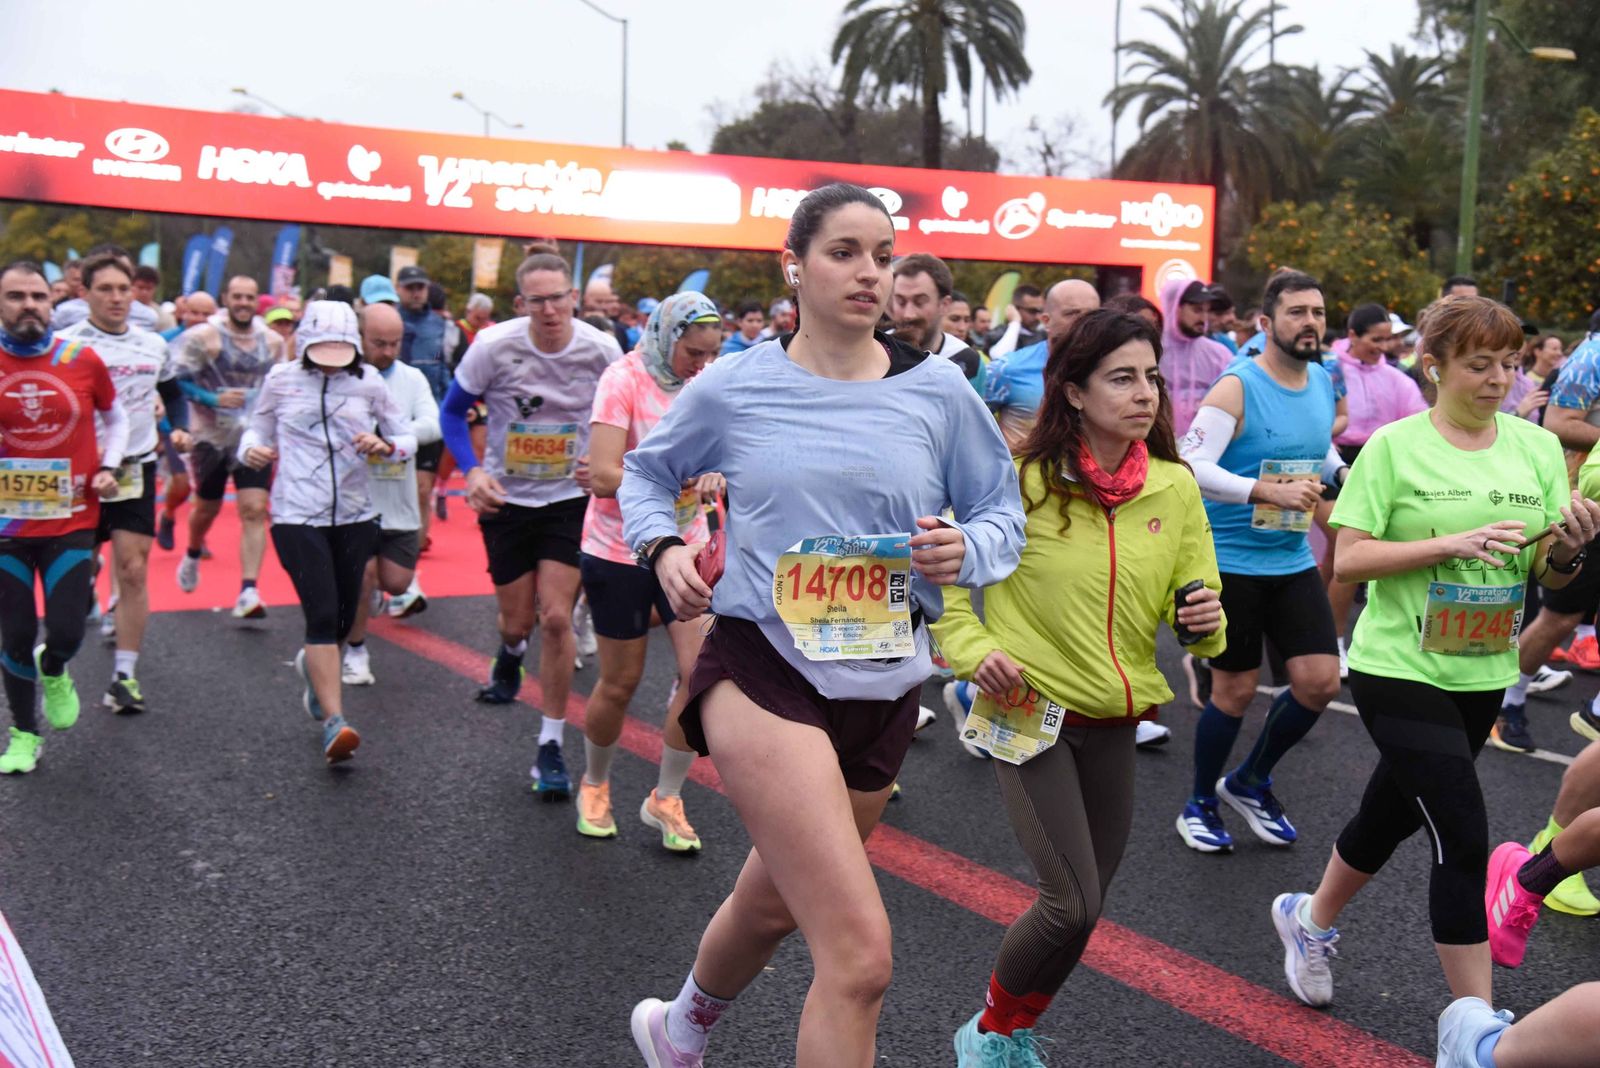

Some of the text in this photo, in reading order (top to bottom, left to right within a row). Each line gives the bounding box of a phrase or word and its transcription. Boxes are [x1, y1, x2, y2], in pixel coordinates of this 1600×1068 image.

[197, 144, 313, 187] HOKA
[513, 437, 566, 455] 16634
[1, 475, 59, 492] 15754
[1414, 489, 1472, 498] Masajes Albert
[788, 562, 888, 602] 14708
[776, 581, 784, 605] CAJÓN
[827, 604, 847, 614] Sheila
[819, 646, 840, 654] HOKA
